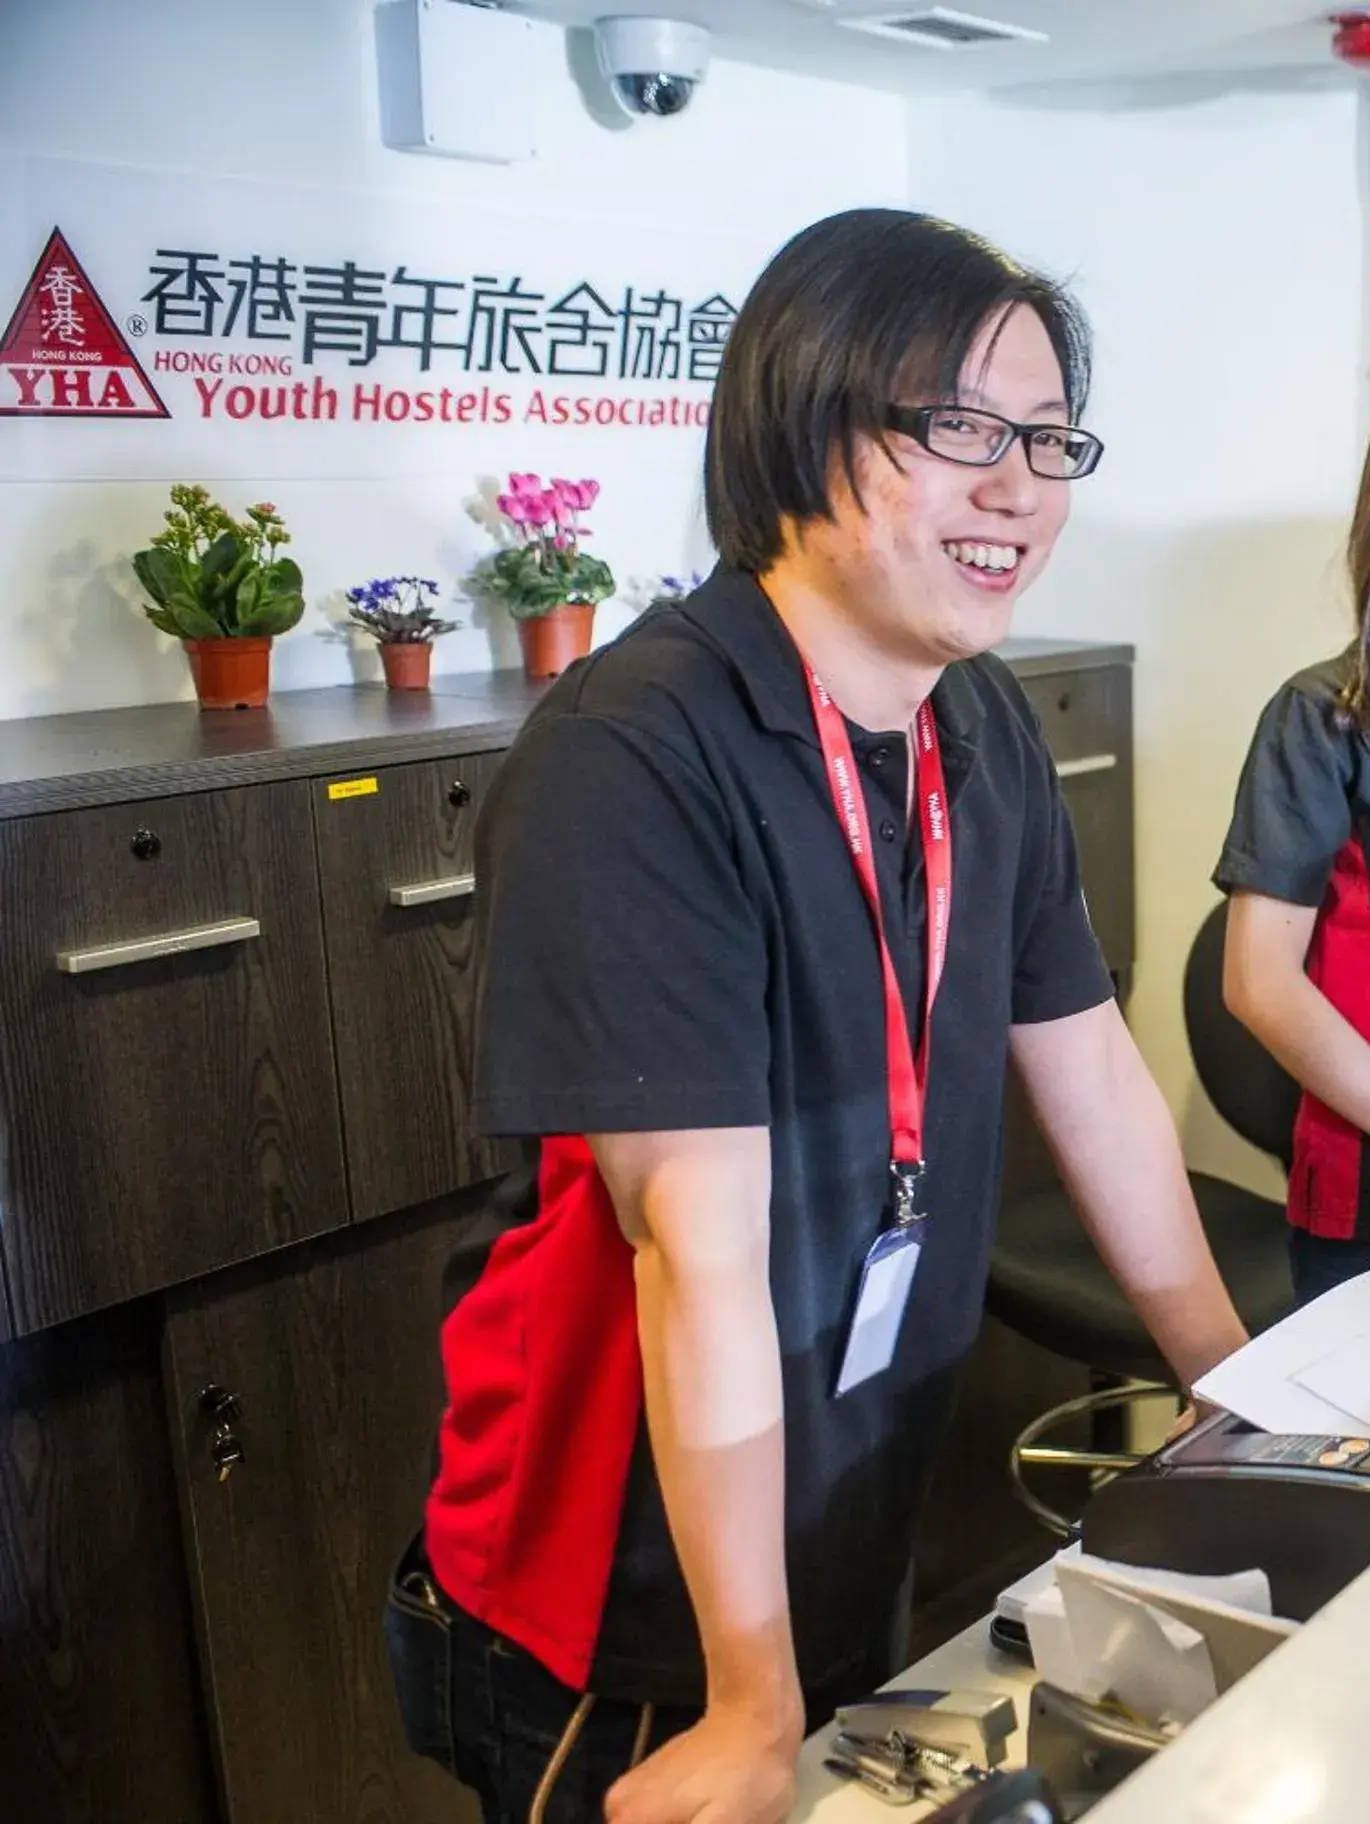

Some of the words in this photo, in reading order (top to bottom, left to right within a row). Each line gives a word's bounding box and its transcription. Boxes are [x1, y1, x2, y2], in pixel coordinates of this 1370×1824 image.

[39, 265, 86, 347] 香港
[141, 249, 741, 381] 香港青年旅舍協會
[32, 350, 67, 361] HONG
[69, 351, 102, 362] KONG
[154, 351, 222, 374] HONG
[229, 354, 292, 376] KONG
[8, 367, 136, 408] YHA
[194, 377, 339, 420] Youth
[353, 384, 512, 424] Hostels
[524, 389, 711, 427] Associatio
